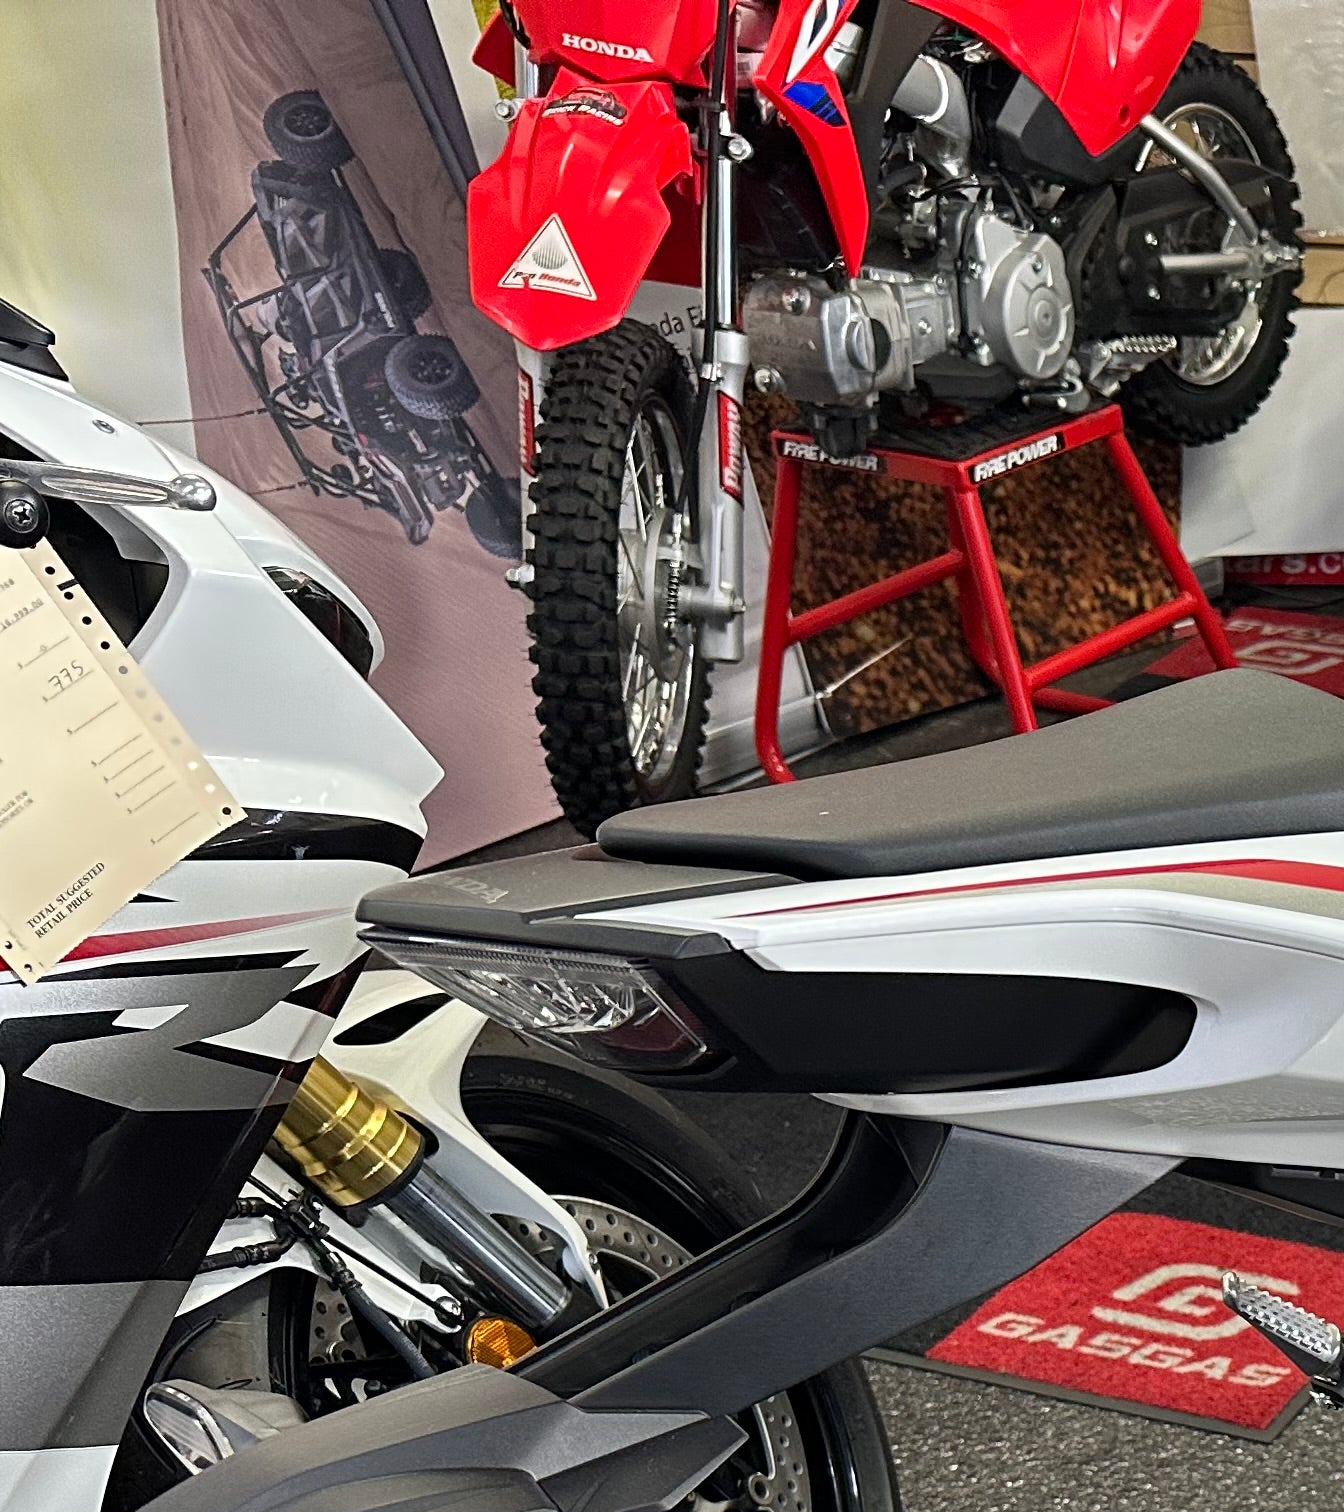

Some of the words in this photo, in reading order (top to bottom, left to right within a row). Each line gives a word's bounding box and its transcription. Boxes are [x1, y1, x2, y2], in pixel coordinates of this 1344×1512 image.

[562, 32, 654, 63] HONDA
[27, 902, 57, 930] TOTAL
[56, 861, 105, 905] SUGGESTED
[34, 911, 67, 939] RETAIL
[66, 888, 94, 914] PRICE
[977, 1311, 1292, 1388] GASGAS
